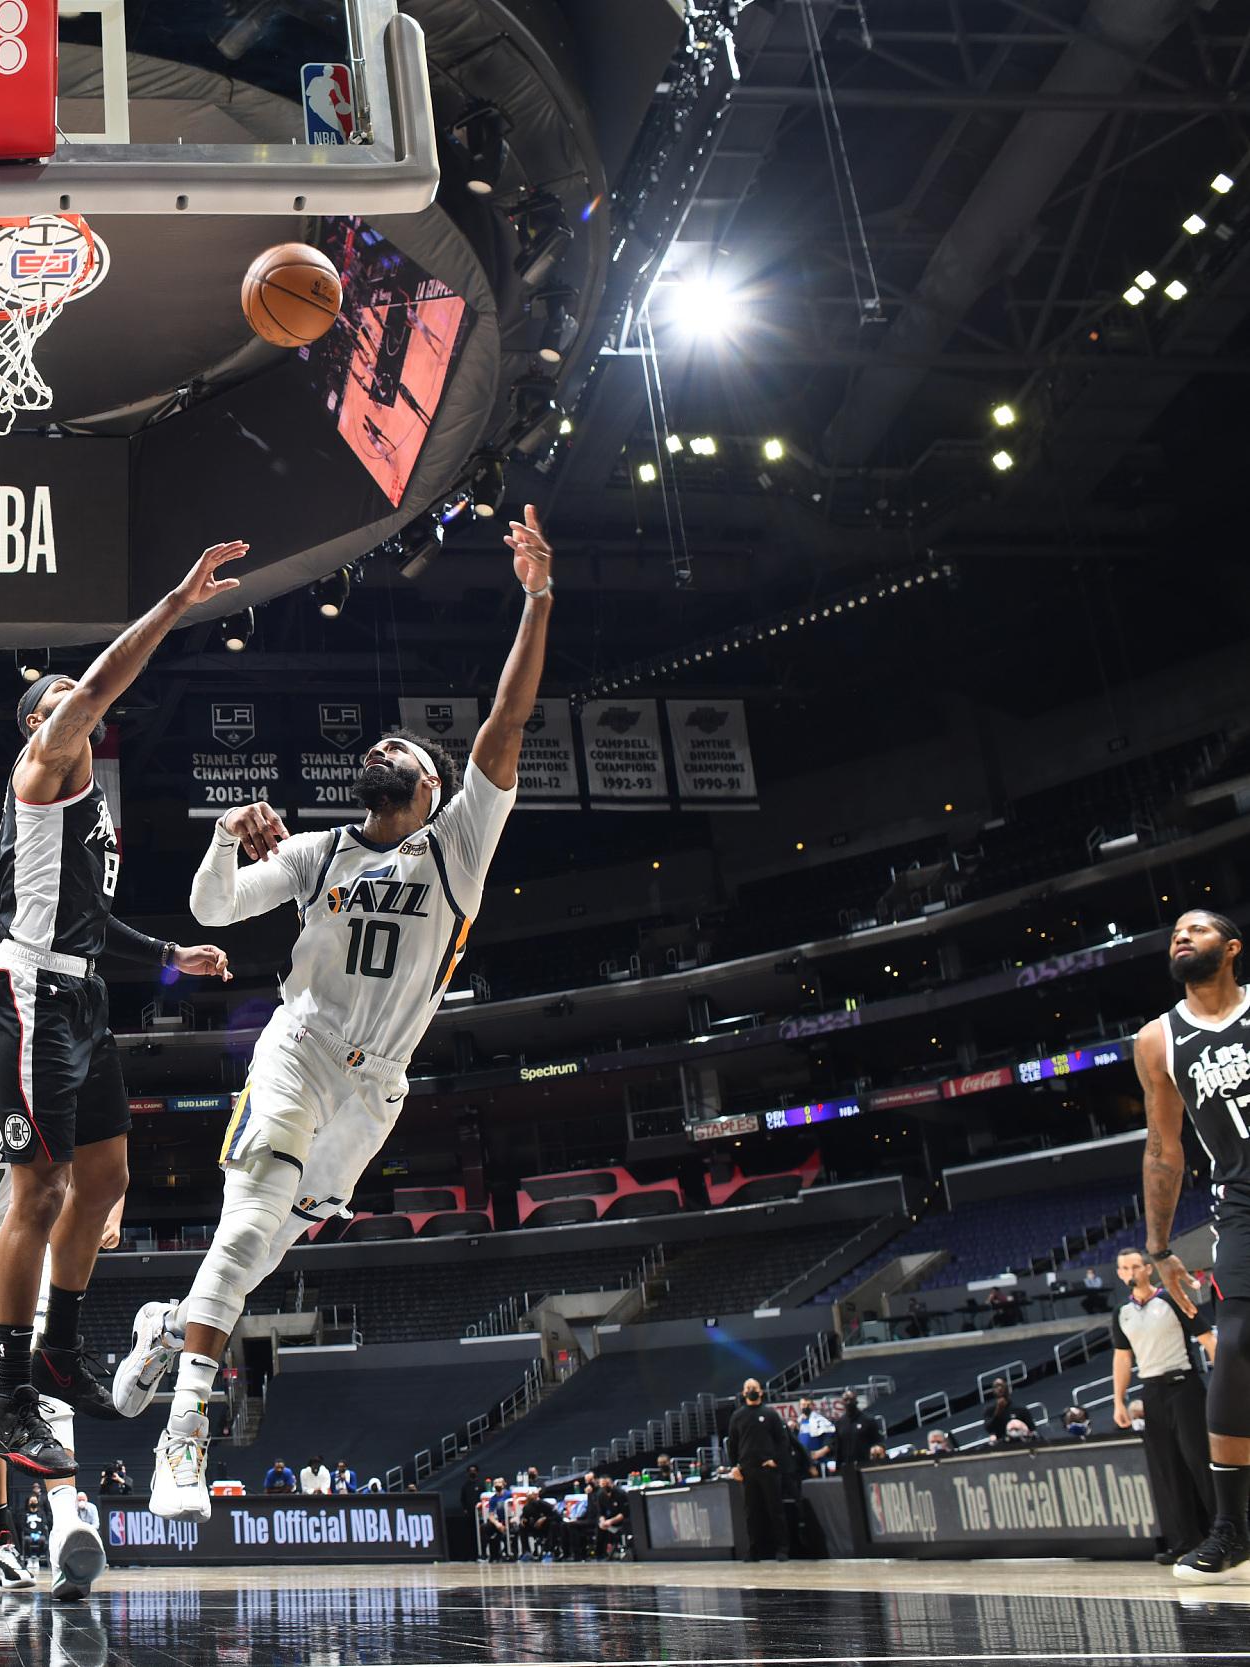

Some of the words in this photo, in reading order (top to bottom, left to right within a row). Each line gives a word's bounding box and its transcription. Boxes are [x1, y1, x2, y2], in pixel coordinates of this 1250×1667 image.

[314, 132, 338, 144] NBA
[215, 708, 251, 723] LA
[323, 708, 358, 723] LA
[595, 739, 650, 749] CAMPBELL
[691, 739, 731, 749] SMYTHE
[192, 753, 248, 766] STANLEY
[252, 753, 278, 766] CUP
[301, 753, 356, 766] STANLEY
[590, 751, 659, 761] CONFERENCE
[690, 751, 736, 761] DIVISION
[193, 766, 279, 780] CHAMPIONS
[517, 762, 569, 772] AMPIONS
[595, 762, 656, 773] CHAMPIONS
[684, 763, 745, 773] CHAMPIONS
[518, 777, 562, 789] 2011-12
[602, 777, 652, 790] 1992-93
[693, 777, 741, 790] 1990-91
[205, 786, 269, 802] 2013-14
[346, 917, 401, 979] 10
[1094, 1052, 1118, 1066] NBA
[520, 1063, 578, 1081] Spectrum
[1018, 1060, 1041, 1073] DEN
[1020, 1070, 1042, 1083] CLE
[177, 1100, 195, 1108] BUD
[838, 1105, 860, 1118] NBA
[694, 1117, 757, 1139] STAPLES
[953, 1476, 990, 1531] The
[988, 1469, 1062, 1530] Official
[1058, 1465, 1108, 1528] NBA
[1104, 1464, 1155, 1538] App
[881, 1482, 913, 1533] NBA
[910, 1481, 937, 1542] App
[127, 1511, 166, 1545] NBA
[231, 1510, 269, 1545] The
[273, 1508, 347, 1545] Official
[351, 1508, 392, 1544] NBA
[395, 1508, 434, 1549] App
